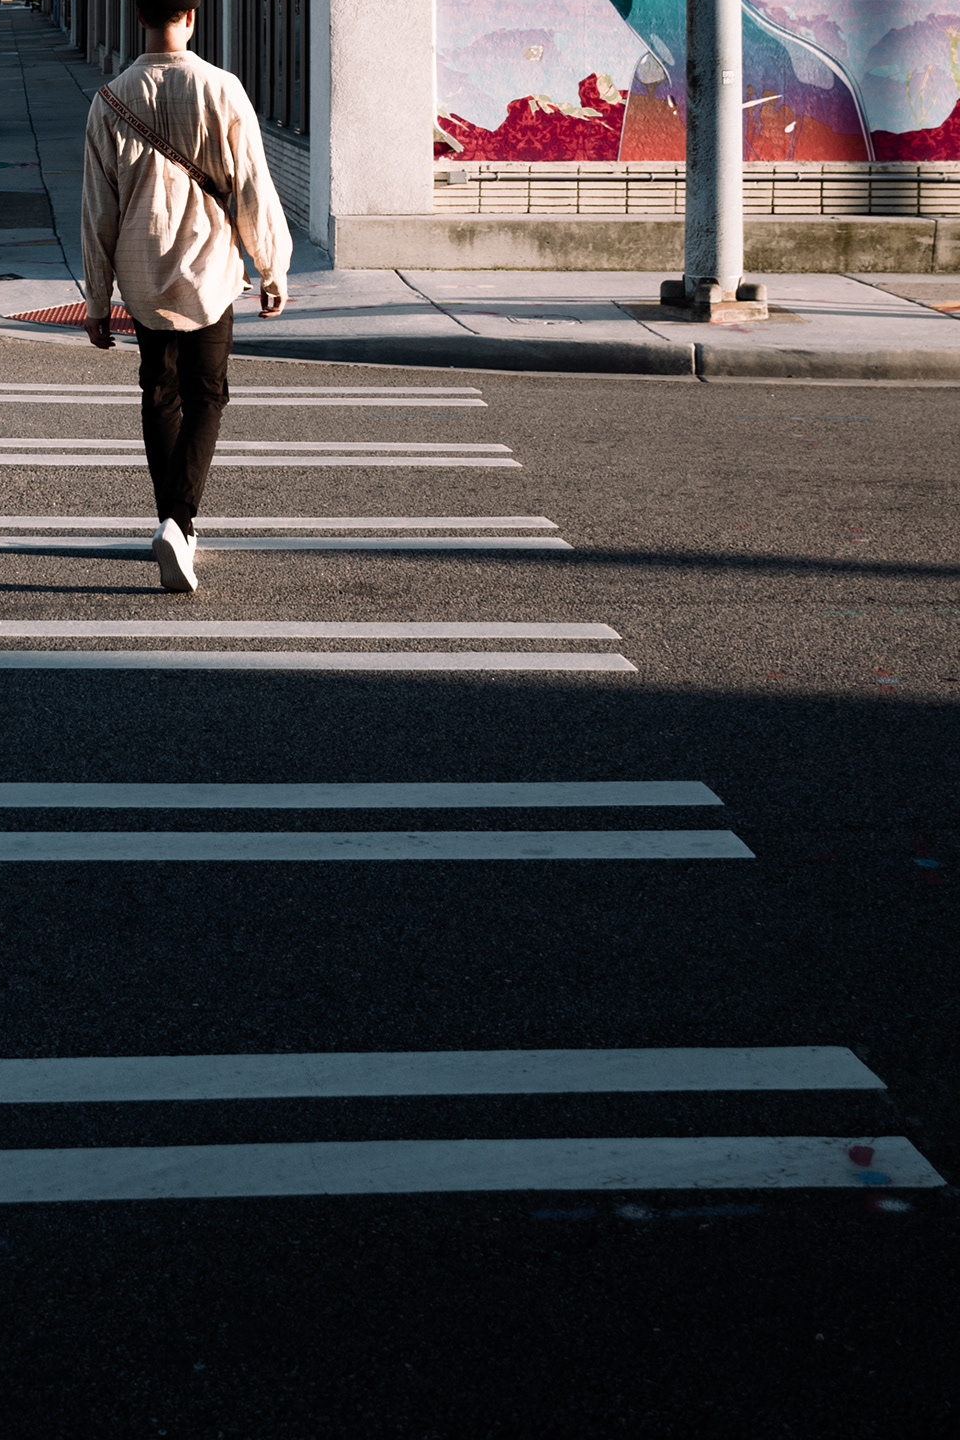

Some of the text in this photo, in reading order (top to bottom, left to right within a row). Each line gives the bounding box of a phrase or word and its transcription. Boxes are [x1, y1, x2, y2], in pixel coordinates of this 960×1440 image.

[110, 96, 127, 117] PENTAX
[128, 114, 148, 135] PENTAX
[147, 132, 169, 153] PENTAX
[169, 150, 190, 170] PENTAX
